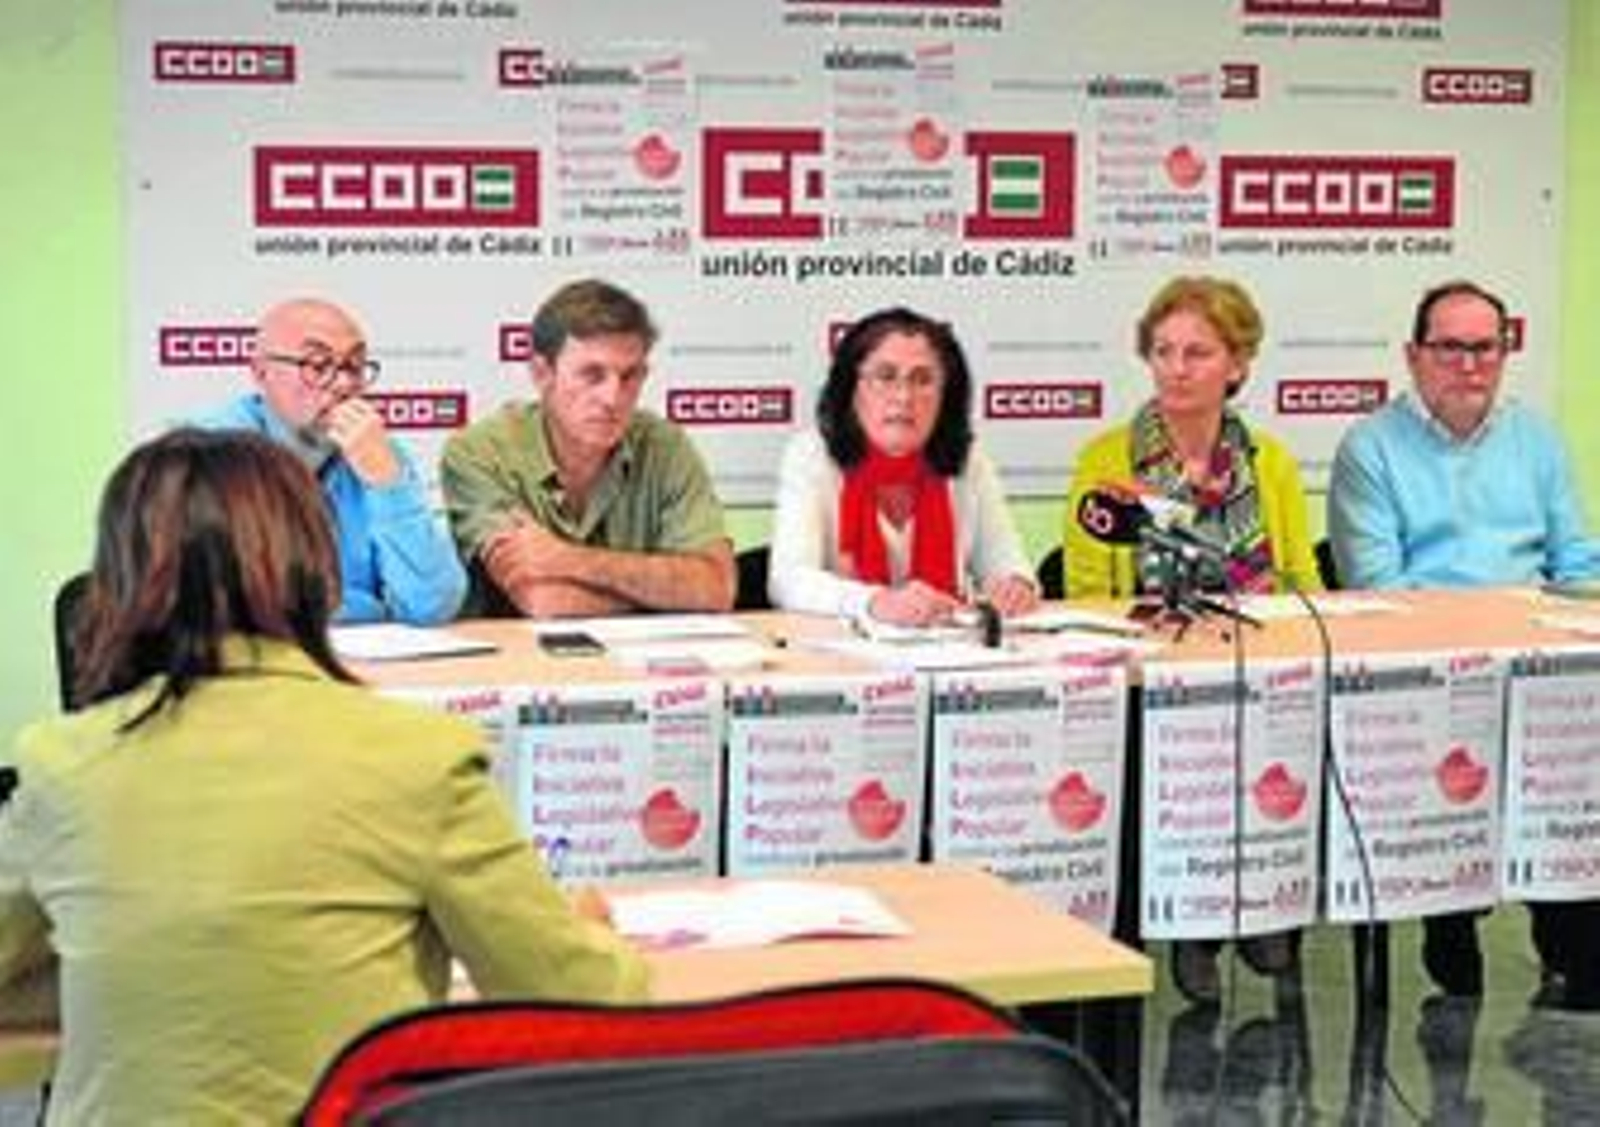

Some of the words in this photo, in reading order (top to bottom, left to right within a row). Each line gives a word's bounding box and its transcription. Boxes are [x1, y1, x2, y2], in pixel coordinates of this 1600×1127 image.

[161, 50, 259, 75] CCOO
[1429, 73, 1504, 95] CCOO
[270, 163, 467, 209] CCOO
[1232, 171, 1393, 214] CCOO
[327, 233, 438, 257] provincial
[447, 235, 471, 253] de
[1374, 236, 1396, 254] de
[703, 249, 787, 277] unión
[797, 251, 943, 281] provincial
[953, 252, 987, 277] de
[995, 248, 1075, 276] Cádiz
[673, 394, 759, 419] CCOO
[991, 391, 1073, 413] CCOO
[1281, 386, 1361, 410] CCOO
